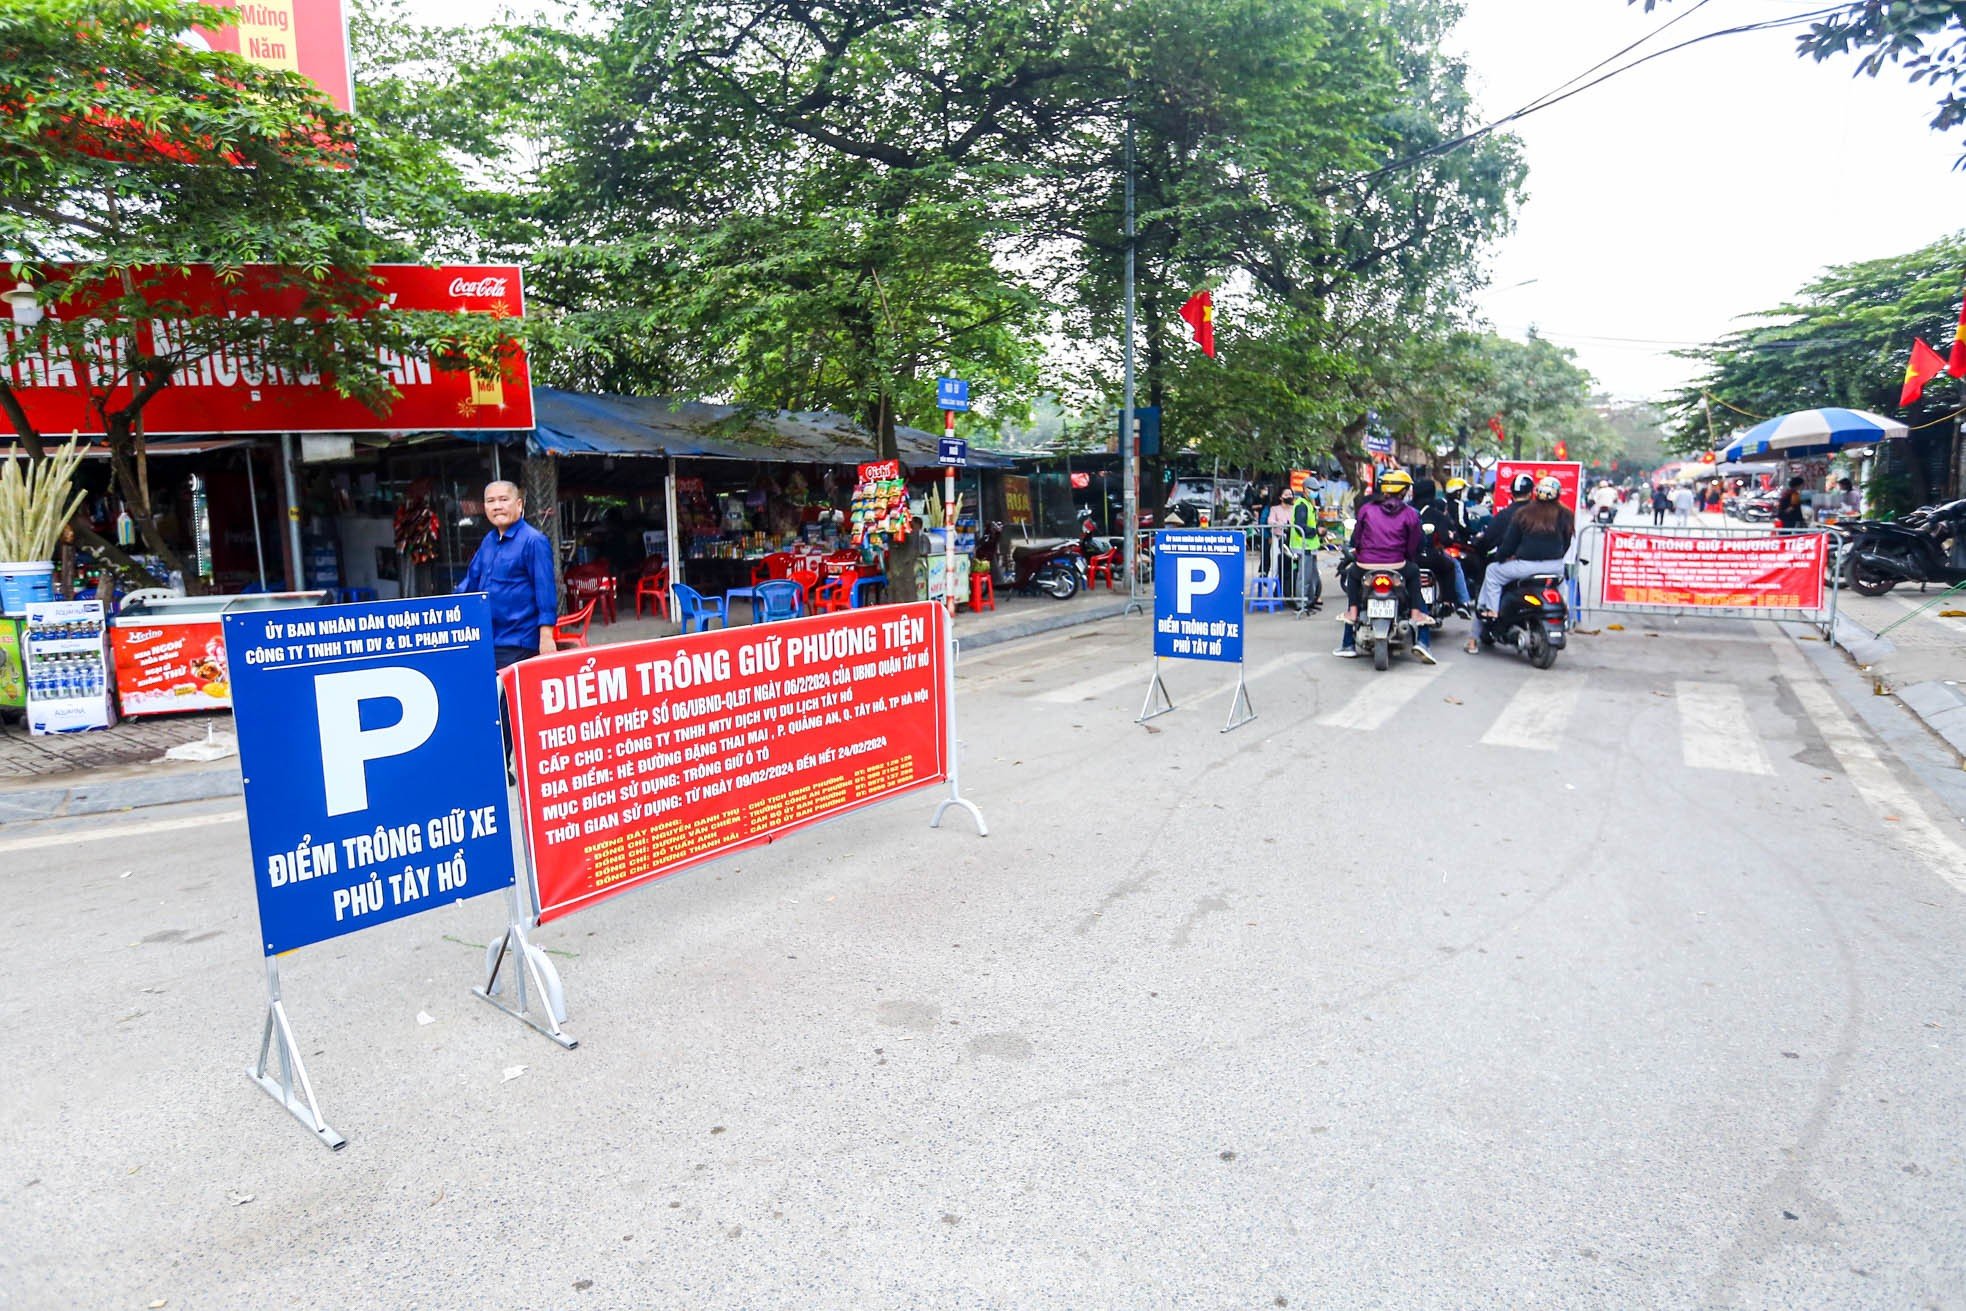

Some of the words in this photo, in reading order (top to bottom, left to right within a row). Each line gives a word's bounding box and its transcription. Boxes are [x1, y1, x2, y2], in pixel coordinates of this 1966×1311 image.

[240, 4, 288, 31] Mừng
[248, 37, 286, 59] Năm
[449, 277, 508, 297] Coca-Cola
[865, 465, 890, 479] Oishi
[1177, 557, 1221, 614] P
[127, 629, 163, 642] Merino
[245, 646, 285, 665] CÔNG
[287, 645, 304, 660] TY
[306, 641, 342, 658] TNHH
[343, 639, 364, 654] TM
[366, 637, 382, 652] DV
[385, 636, 395, 650] &
[397, 634, 413, 649] DL
[415, 630, 449, 648] PHẠM
[265, 620, 283, 640] ỦY
[286, 621, 316, 638] BAN
[318, 616, 356, 635] NHÂN
[358, 614, 385, 631] DÂN
[387, 610, 420, 630] QUẬN
[422, 608, 443, 625] TÂY
[1158, 614, 1180, 634] ĐIỂM
[1181, 618, 1208, 636] TRÔNG
[1210, 620, 1226, 637] GIỮ
[1227, 623, 1239, 638] XE
[1173, 636, 1190, 653] PHỦ
[1192, 638, 1208, 655] TÂY
[540, 657, 628, 715] ĐIỂM
[635, 649, 731, 696] TRÔNG
[738, 634, 782, 676] GIỮ
[787, 625, 877, 667] PHƯƠNG
[881, 614, 924, 652] TIỆN
[538, 724, 577, 750] THEO
[579, 711, 611, 742] GIẤY
[614, 707, 649, 734] PHÉP
[652, 698, 670, 726] SỐ
[753, 679, 782, 703] NGÀY
[783, 671, 831, 697] 06/2/2024
[832, 663, 852, 686] CỦA
[852, 662, 877, 682] UBND
[878, 655, 902, 677] QUẬN
[902, 652, 917, 671] TÂY
[314, 666, 439, 817] P
[538, 752, 570, 775] CẤP
[574, 747, 604, 767] CHO
[615, 736, 653, 757] CÔNG
[655, 731, 670, 747] TY
[673, 723, 706, 743] TNHH
[708, 717, 733, 735] MTV
[734, 710, 761, 729] DỊCH
[763, 706, 778, 722] VỤ
[779, 702, 794, 717] DU
[796, 697, 820, 715] LỊCH
[820, 692, 838, 708] TÂY
[541, 779, 569, 799] ĐỊA
[571, 766, 614, 791] ĐIỂM:
[616, 760, 635, 779] HÈ
[637, 750, 682, 774] ĐƯỜNG
[684, 741, 717, 762] ĐẶNG
[719, 734, 745, 752] THAI
[747, 727, 769, 745] MAI
[777, 724, 786, 737] P.
[788, 714, 823, 735] QUẢNG
[824, 711, 842, 725] AN,
[842, 708, 853, 721] Q.
[854, 702, 871, 718] TÂY
[888, 696, 900, 709] TP
[900, 691, 913, 706] HÀ
[913, 687, 929, 703] NỘI
[542, 799, 579, 822] MỤC
[582, 789, 617, 811] ĐÍCH
[619, 779, 639, 801] SỬ
[641, 773, 681, 795] DỤNG:
[682, 760, 722, 783] TRÔNG
[724, 752, 745, 771] GIỮ
[745, 749, 754, 765] Ô
[755, 745, 770, 762] TÔ
[545, 822, 581, 845] THỜI
[584, 812, 620, 834] GIAN
[622, 802, 642, 824] SỬ
[643, 795, 683, 817] DỤNG:
[684, 786, 701, 804] TỪ
[702, 778, 733, 799] NGÀY
[735, 761, 795, 789] 09/02/2024
[796, 753, 817, 771] ĐẾN
[818, 746, 836, 765] HẾT
[838, 735, 888, 759] 24/02/2024
[268, 833, 337, 888] ĐIỂM
[342, 823, 423, 869] TRÔNG
[427, 808, 466, 849] GIỮ
[469, 805, 498, 839] XE
[333, 871, 384, 921] PHỦ
[388, 865, 430, 905] TÂY
[436, 848, 467, 892] HỒ
